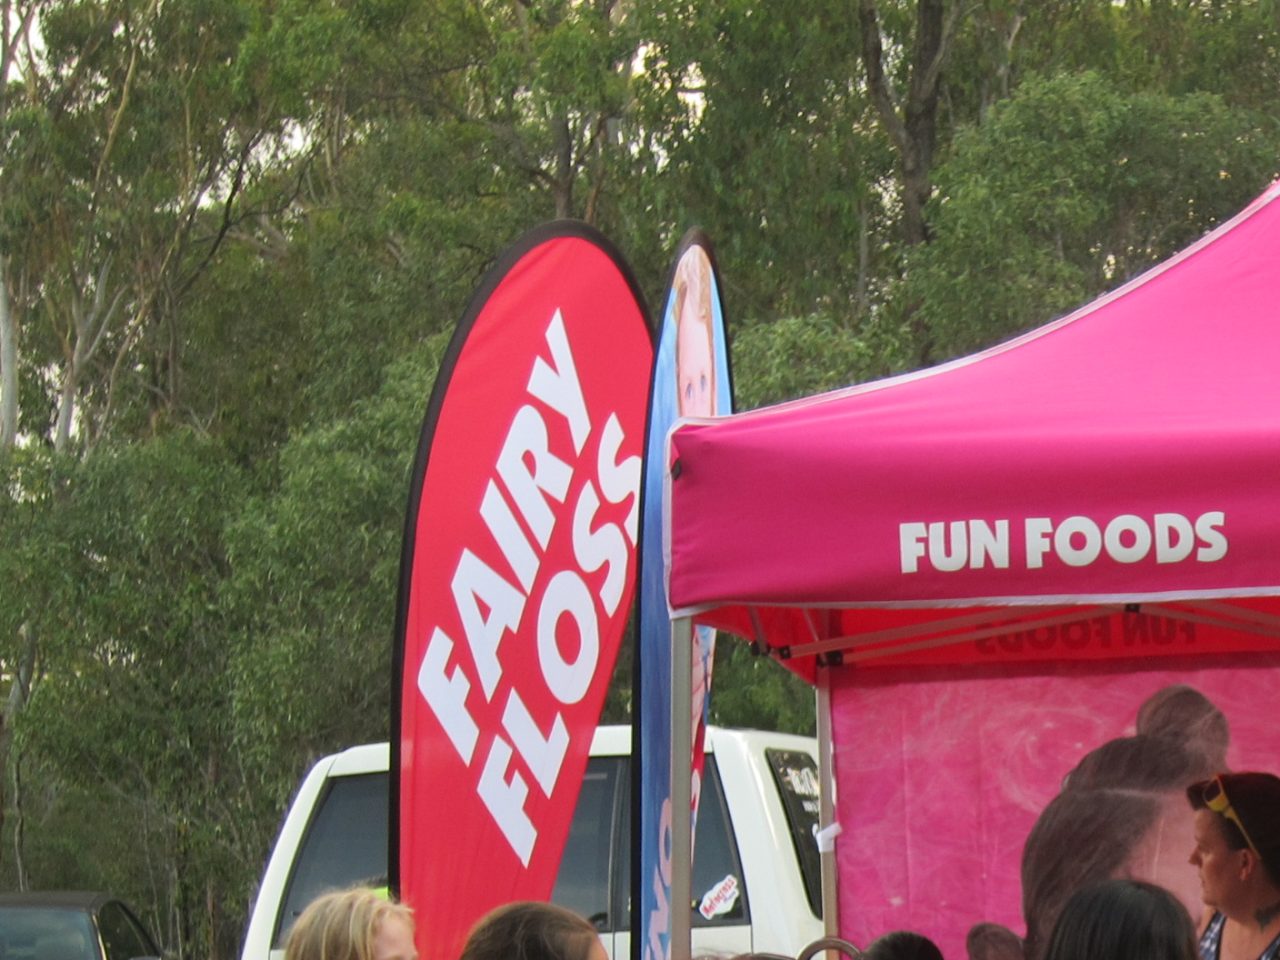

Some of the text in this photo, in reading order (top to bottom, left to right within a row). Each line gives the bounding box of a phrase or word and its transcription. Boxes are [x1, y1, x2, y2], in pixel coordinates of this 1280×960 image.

[417, 307, 592, 768] FAIRY
[476, 411, 642, 869] FLOSS
[899, 511, 1229, 574] FUN FOODS
